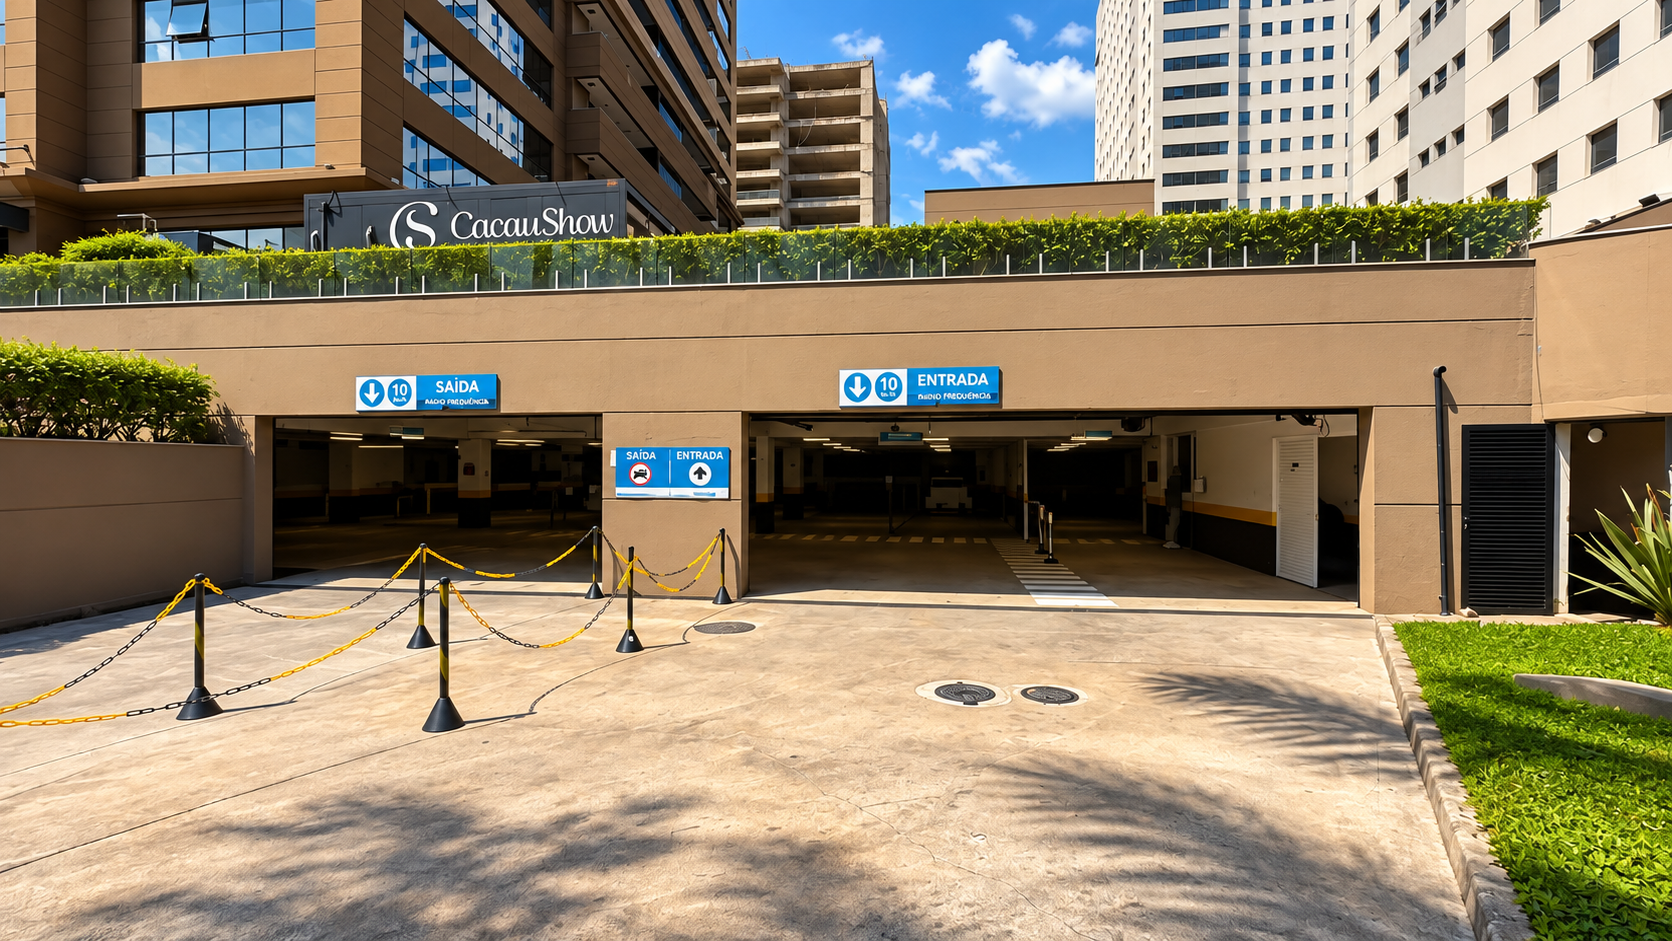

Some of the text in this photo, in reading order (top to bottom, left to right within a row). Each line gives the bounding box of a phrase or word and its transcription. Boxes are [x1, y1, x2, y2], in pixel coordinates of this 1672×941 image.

[880, 377, 898, 391] 10
[918, 373, 989, 387] ENTRADA
[392, 383, 408, 396] 10
[626, 449, 656, 460] SAÍDA
[676, 451, 723, 460] ENTRADA
